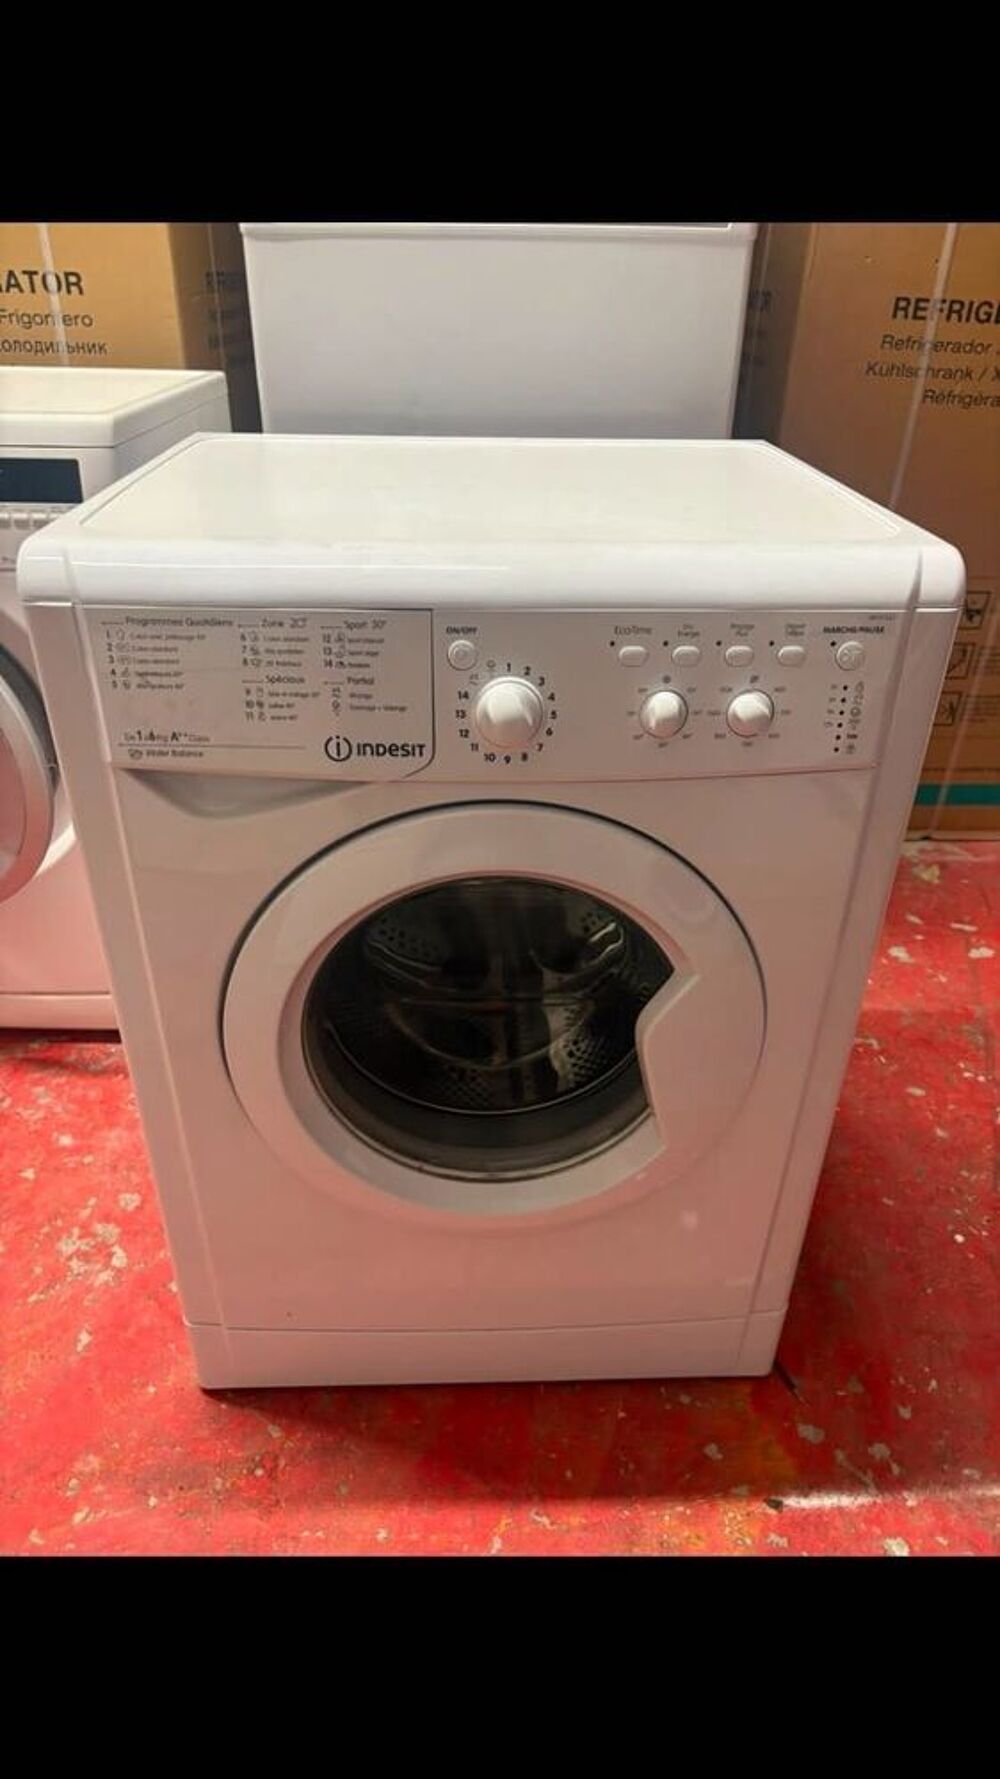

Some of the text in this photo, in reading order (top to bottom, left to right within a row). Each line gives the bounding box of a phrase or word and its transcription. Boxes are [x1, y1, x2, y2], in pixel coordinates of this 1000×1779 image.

[0, 269, 84, 296] ATOR
[506, 662, 512, 673] 1
[523, 666, 531, 676] 2
[538, 677, 545, 686] 3
[458, 690, 469, 700] 14
[547, 692, 556, 701] 4
[456, 709, 467, 719] 13
[550, 710, 558, 719] 5
[459, 729, 470, 738] 12
[546, 727, 554, 737] 6
[470, 743, 480, 752] 11
[537, 743, 544, 752] 7
[484, 753, 496, 763] 10
[503, 755, 512, 765] 9
[521, 752, 529, 762] 8
